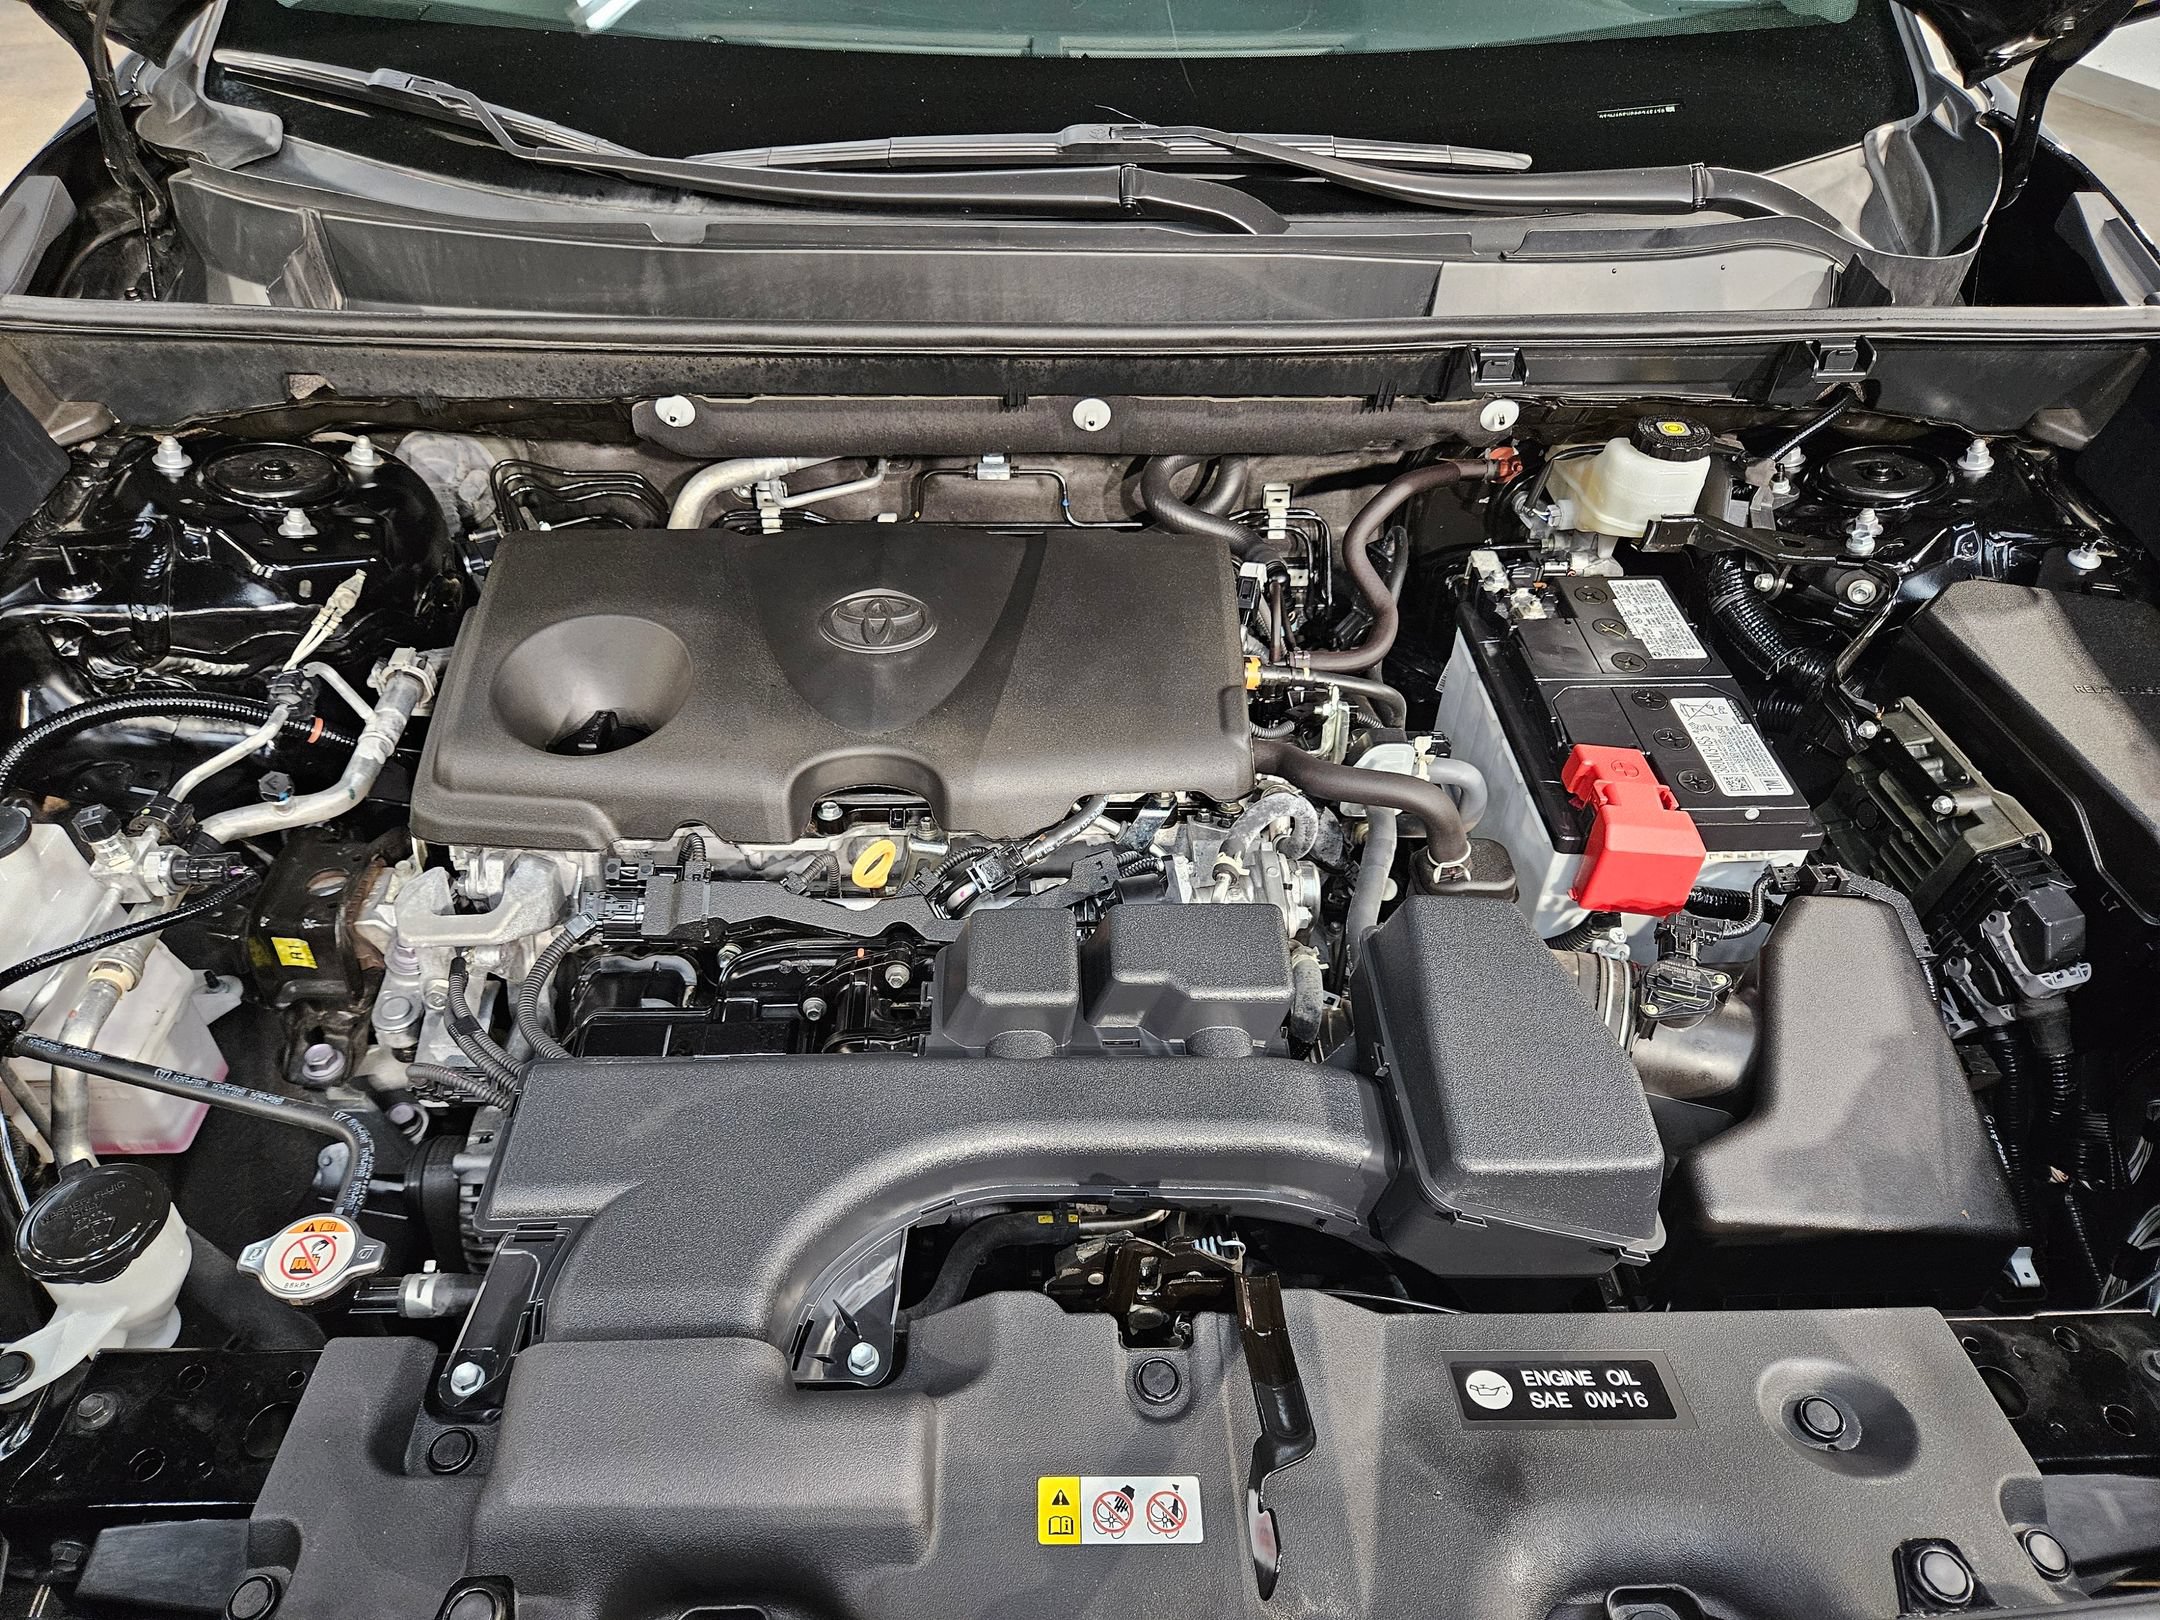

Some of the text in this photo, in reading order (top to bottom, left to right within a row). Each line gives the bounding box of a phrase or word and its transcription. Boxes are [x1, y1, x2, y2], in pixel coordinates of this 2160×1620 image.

[79, 805, 102, 823] H
[1520, 1369, 1641, 1387] ENGINE OIL
[1529, 1391, 1648, 1408] SAE 0W-16
